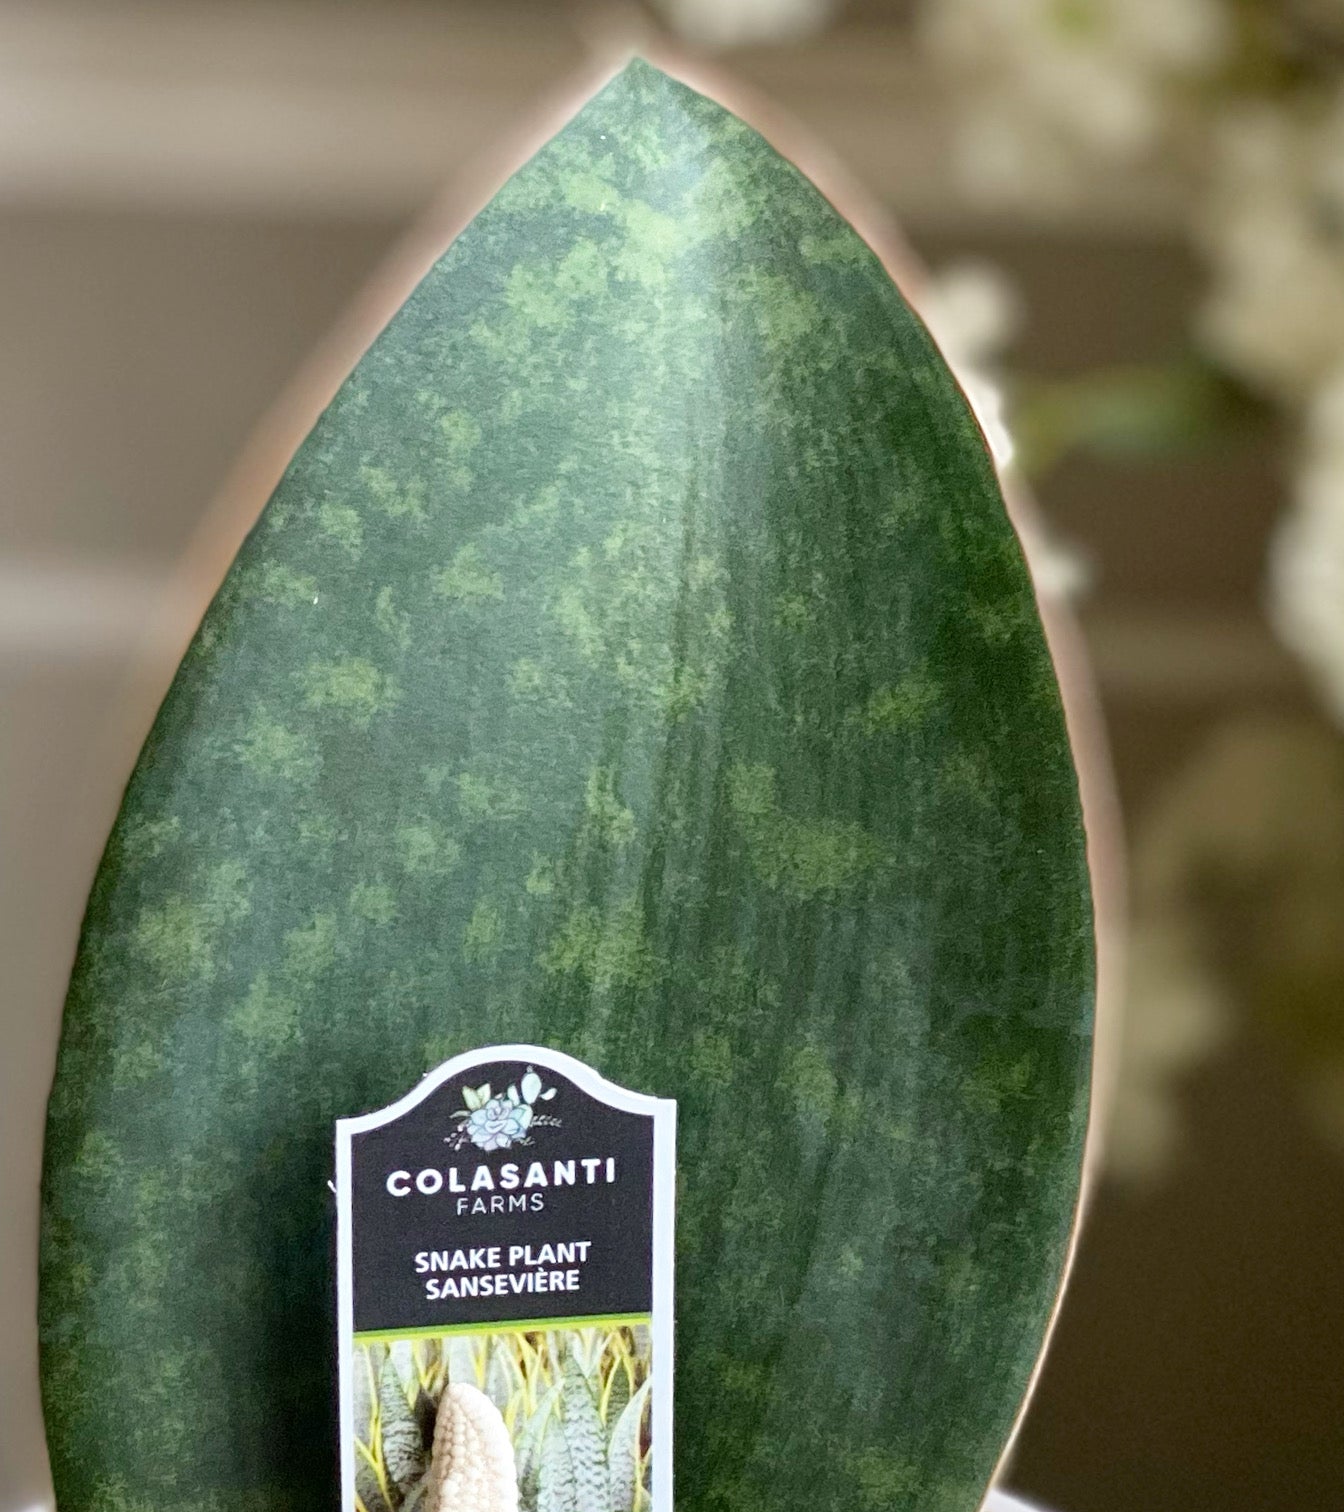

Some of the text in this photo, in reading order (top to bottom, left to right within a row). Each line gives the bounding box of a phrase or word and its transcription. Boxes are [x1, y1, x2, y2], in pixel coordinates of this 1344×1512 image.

[386, 1157, 616, 1197] COLASANTI
[456, 1193, 545, 1216] FARMS
[414, 1241, 592, 1273] SNAKE PLANT
[425, 1267, 581, 1301] SANSEVIÈRE
